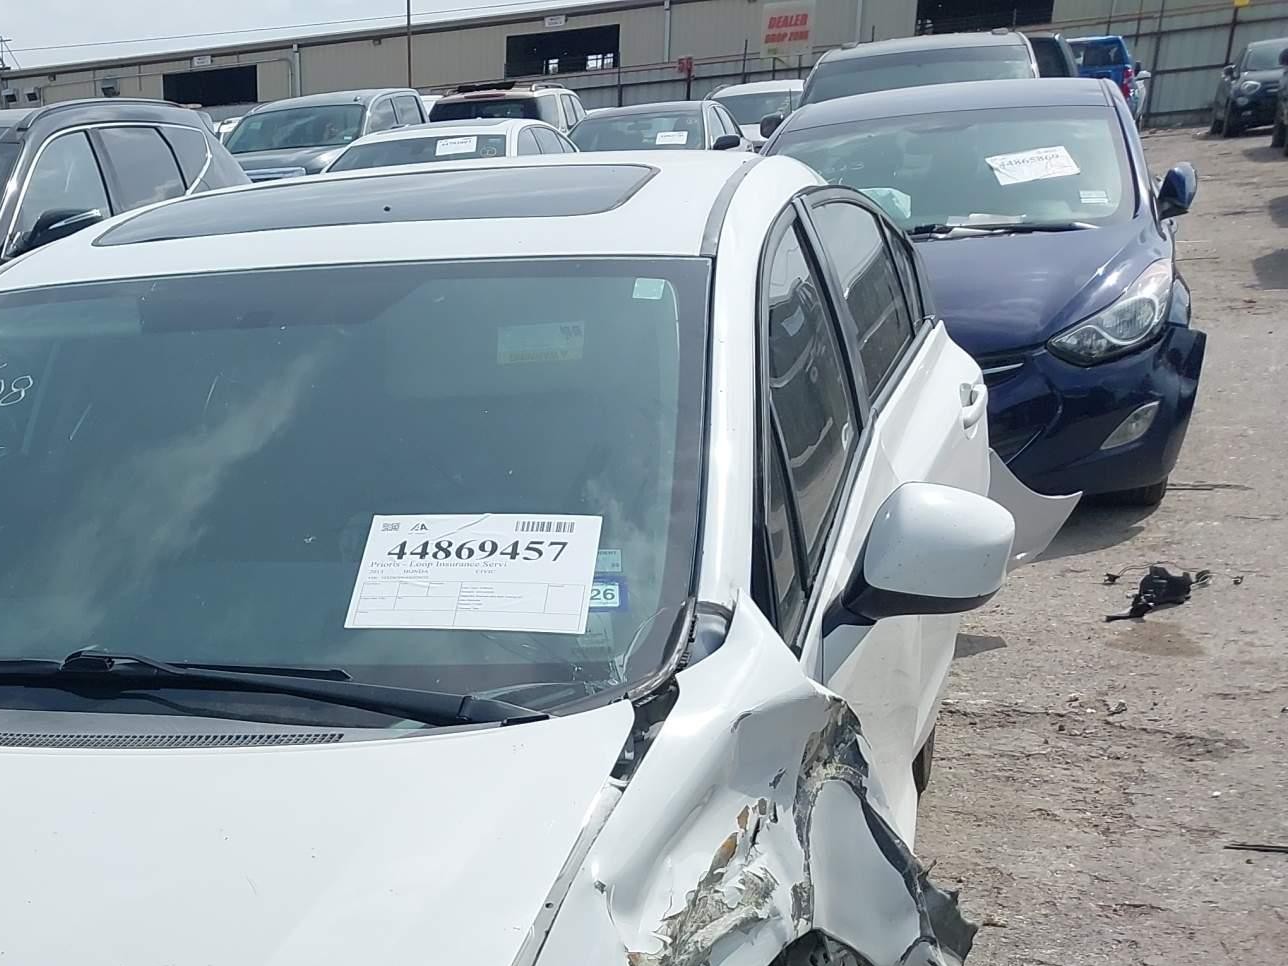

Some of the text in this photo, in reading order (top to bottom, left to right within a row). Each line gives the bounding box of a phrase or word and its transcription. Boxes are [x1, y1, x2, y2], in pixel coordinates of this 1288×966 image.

[767, 13, 808, 29] DEALER
[387, 539, 569, 561] 44869457
[436, 560, 480, 568] Insurance
